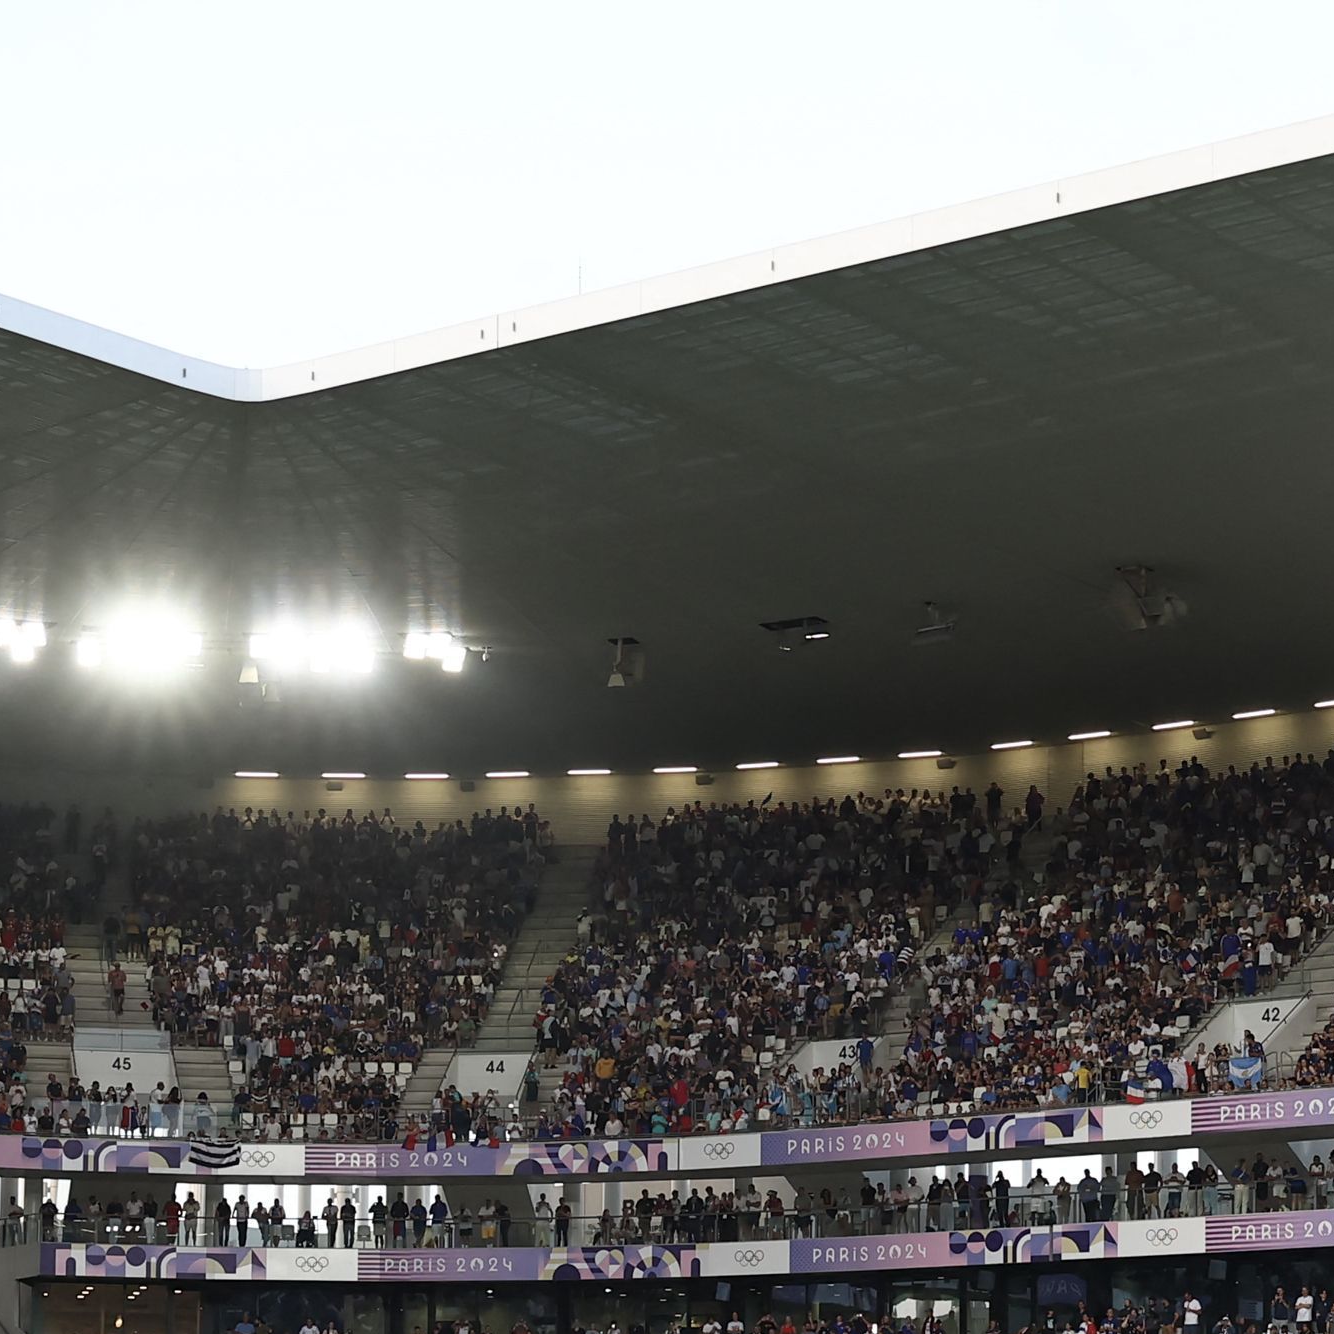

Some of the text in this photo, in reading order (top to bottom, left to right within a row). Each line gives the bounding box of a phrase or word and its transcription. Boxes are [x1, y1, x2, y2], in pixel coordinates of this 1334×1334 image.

[1261, 1007, 1281, 1022] 42
[838, 1045, 856, 1060] 43
[111, 1057, 132, 1072] 45
[485, 1060, 505, 1075] 44
[853, 1131, 906, 1150] 2024
[409, 1152, 468, 1169] 2024
[876, 1242, 927, 1261] 2024
[456, 1257, 513, 1273] 2024
